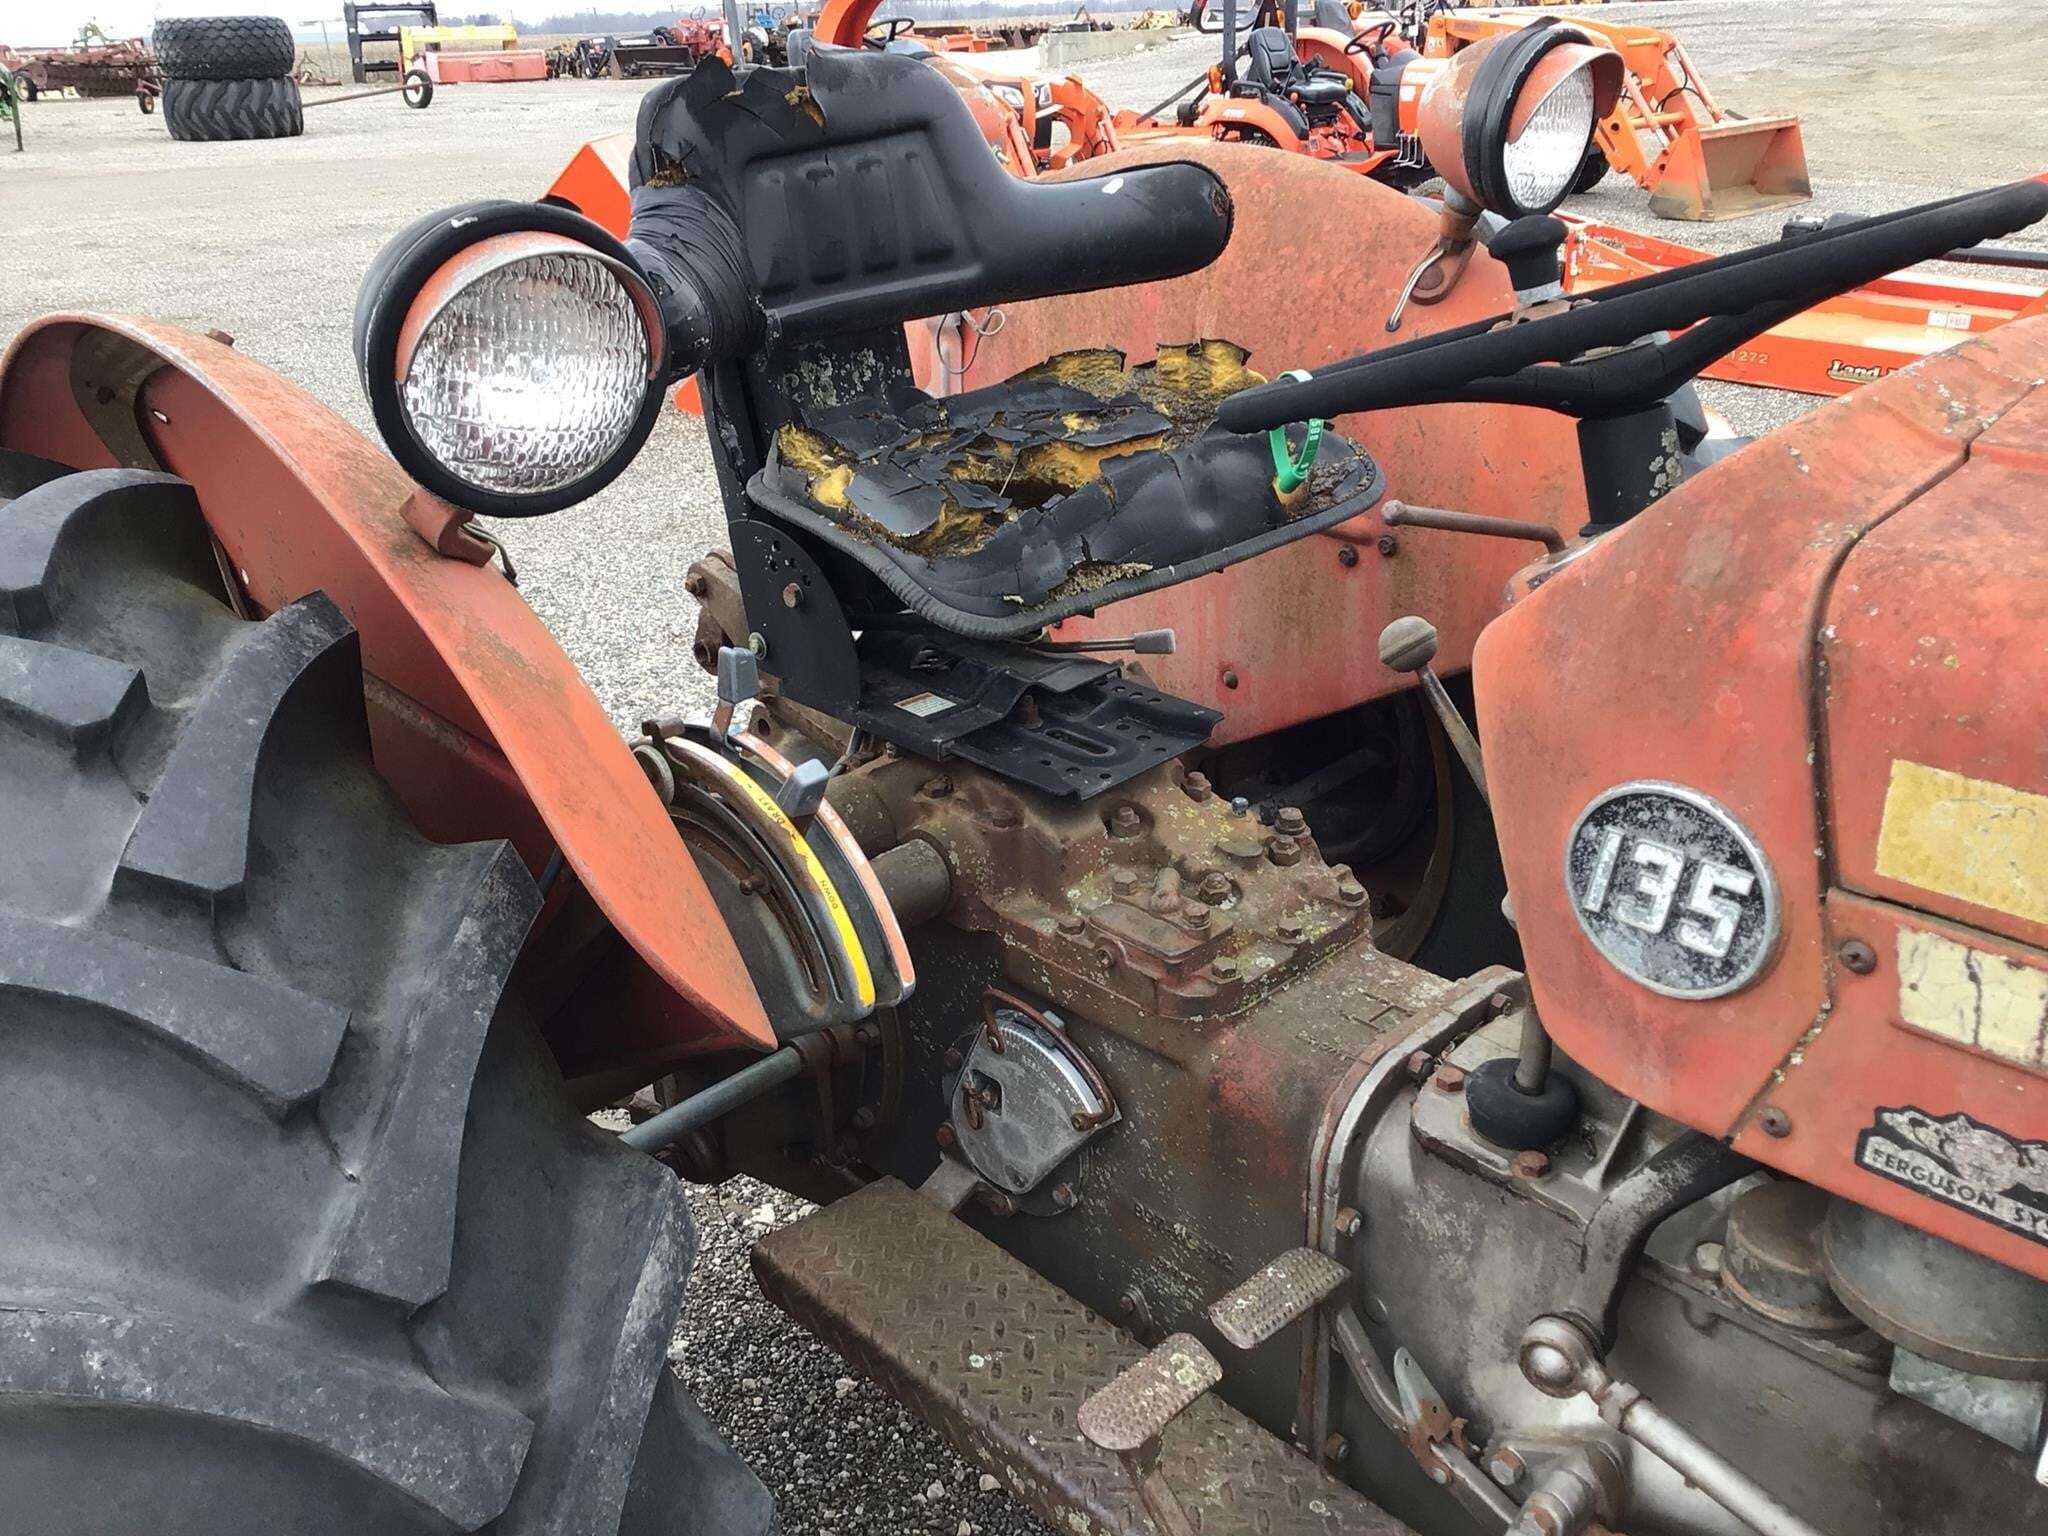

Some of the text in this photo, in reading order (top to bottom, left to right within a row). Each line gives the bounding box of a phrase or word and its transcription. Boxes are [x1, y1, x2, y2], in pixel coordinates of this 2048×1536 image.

[1727, 351, 1768, 364] 1272
[1829, 359, 1881, 378] Land
[758, 797, 786, 824] DRAFT
[820, 880, 839, 910] DOWN
[1582, 825, 1755, 958] 135
[1871, 1148, 1997, 1210] FERGUSON
